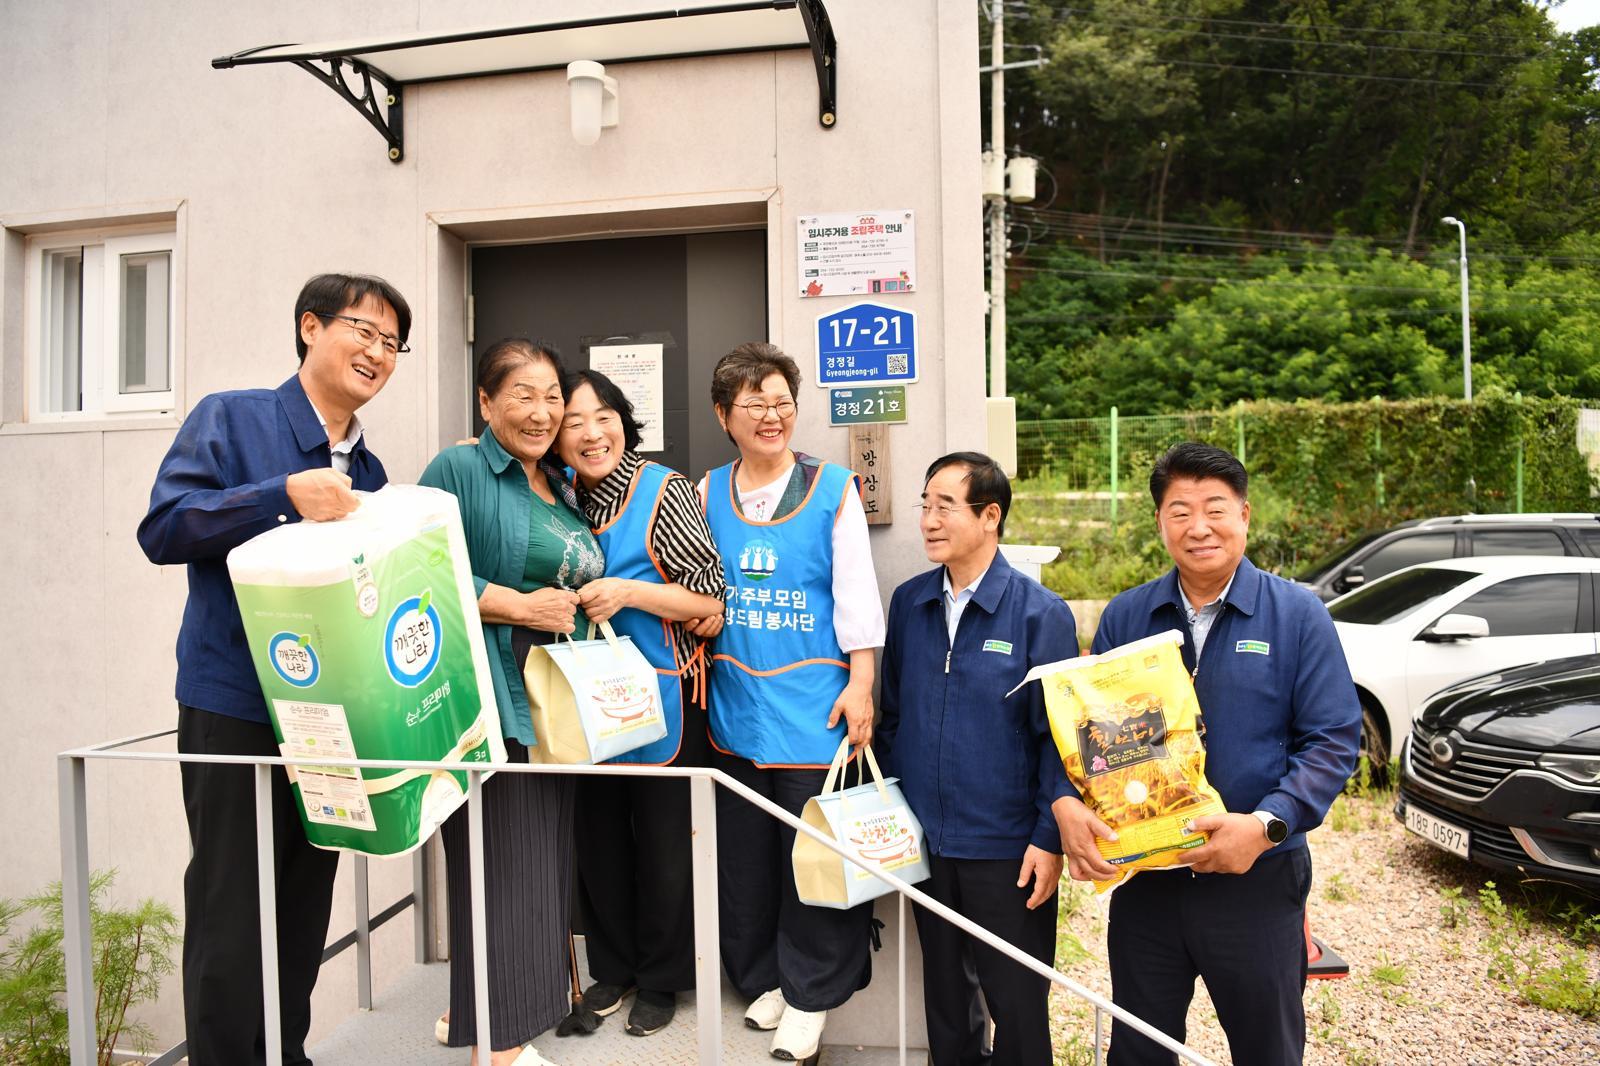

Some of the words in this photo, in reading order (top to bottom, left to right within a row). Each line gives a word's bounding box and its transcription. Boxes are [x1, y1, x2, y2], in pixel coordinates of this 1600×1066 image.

[808, 227, 848, 238] 임시주거용
[851, 224, 883, 235] 조립주택
[885, 223, 902, 234] 안내
[830, 316, 902, 347] 17-21
[826, 356, 855, 368] 경정길
[826, 367, 878, 378] Gyeongjeong-gil
[835, 402, 860, 416] 경정
[863, 399, 901, 415] 21호
[861, 449, 879, 514] 방상도
[394, 618, 430, 651] 깨끗한
[278, 648, 308, 662] 깨끗한
[405, 641, 428, 664] 나라
[286, 662, 306, 674] 나라
[1433, 822, 1462, 849] 0597
